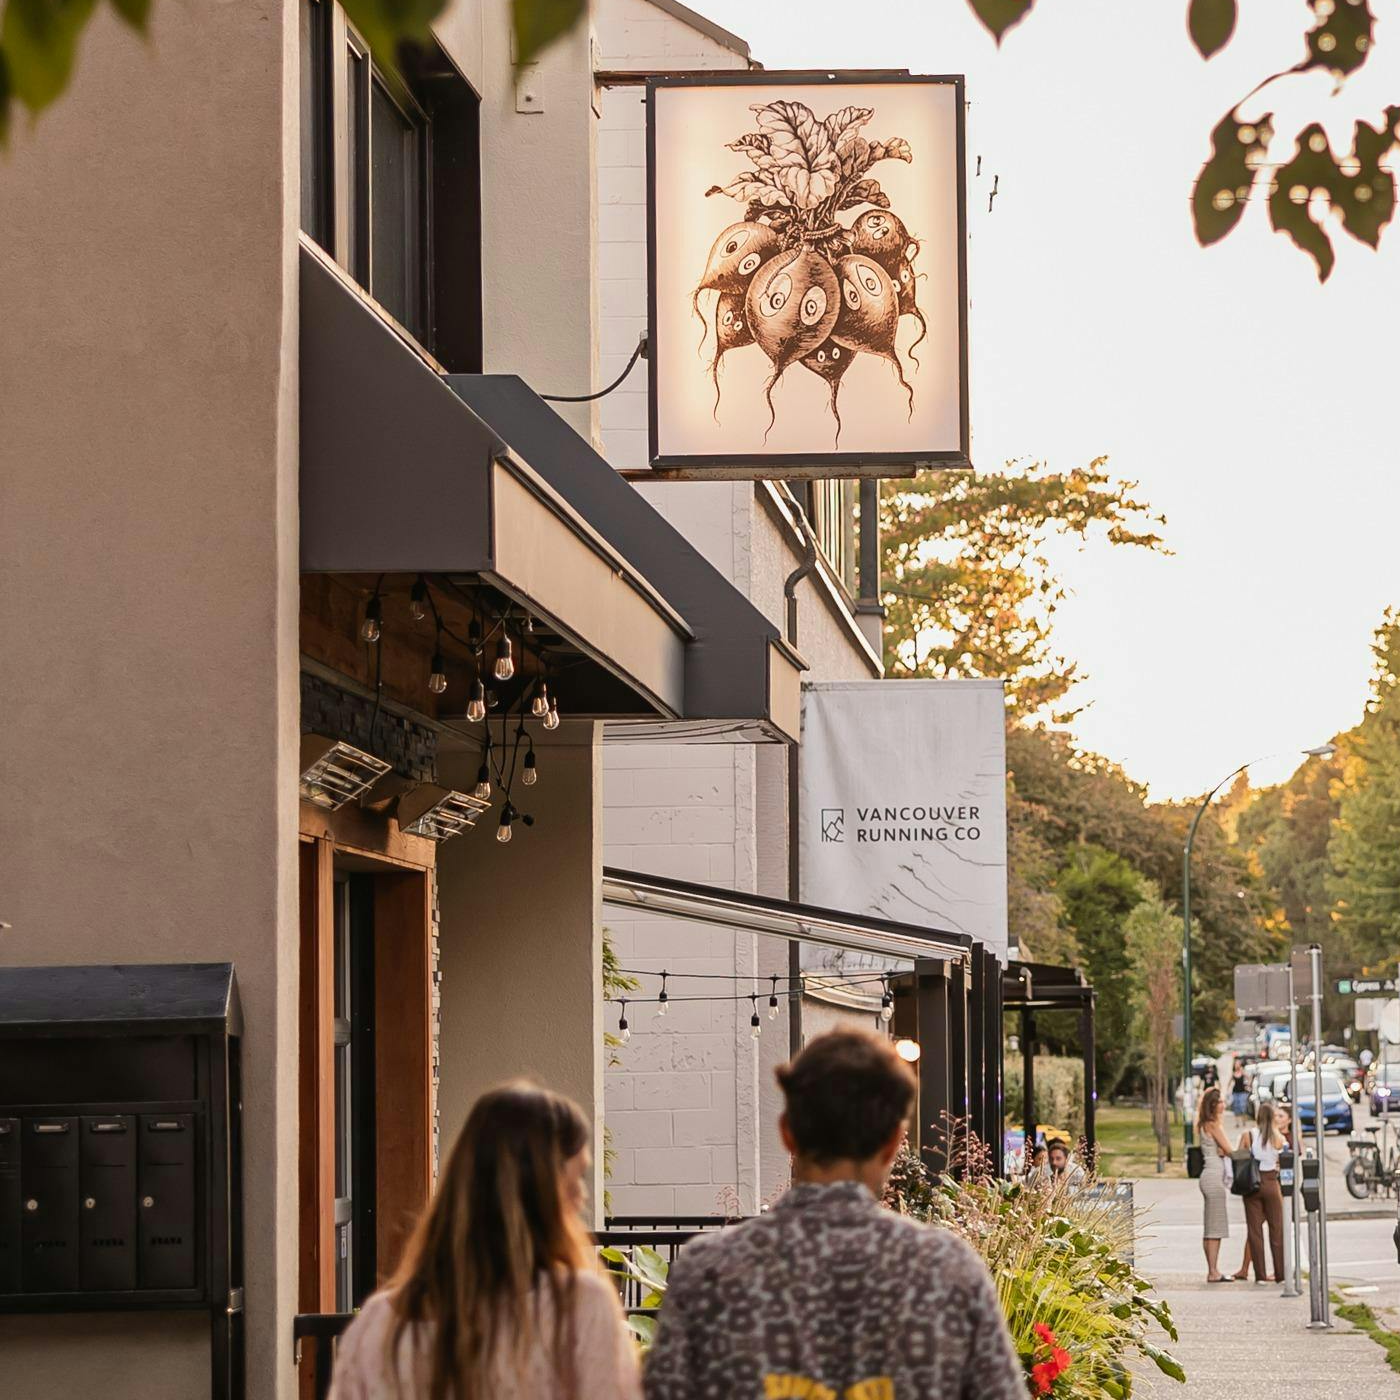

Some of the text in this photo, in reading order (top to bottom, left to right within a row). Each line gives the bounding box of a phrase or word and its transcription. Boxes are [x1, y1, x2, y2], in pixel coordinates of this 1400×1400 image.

[857, 806, 980, 822] VANCOUVER
[857, 826, 981, 842] RUNNING CO
